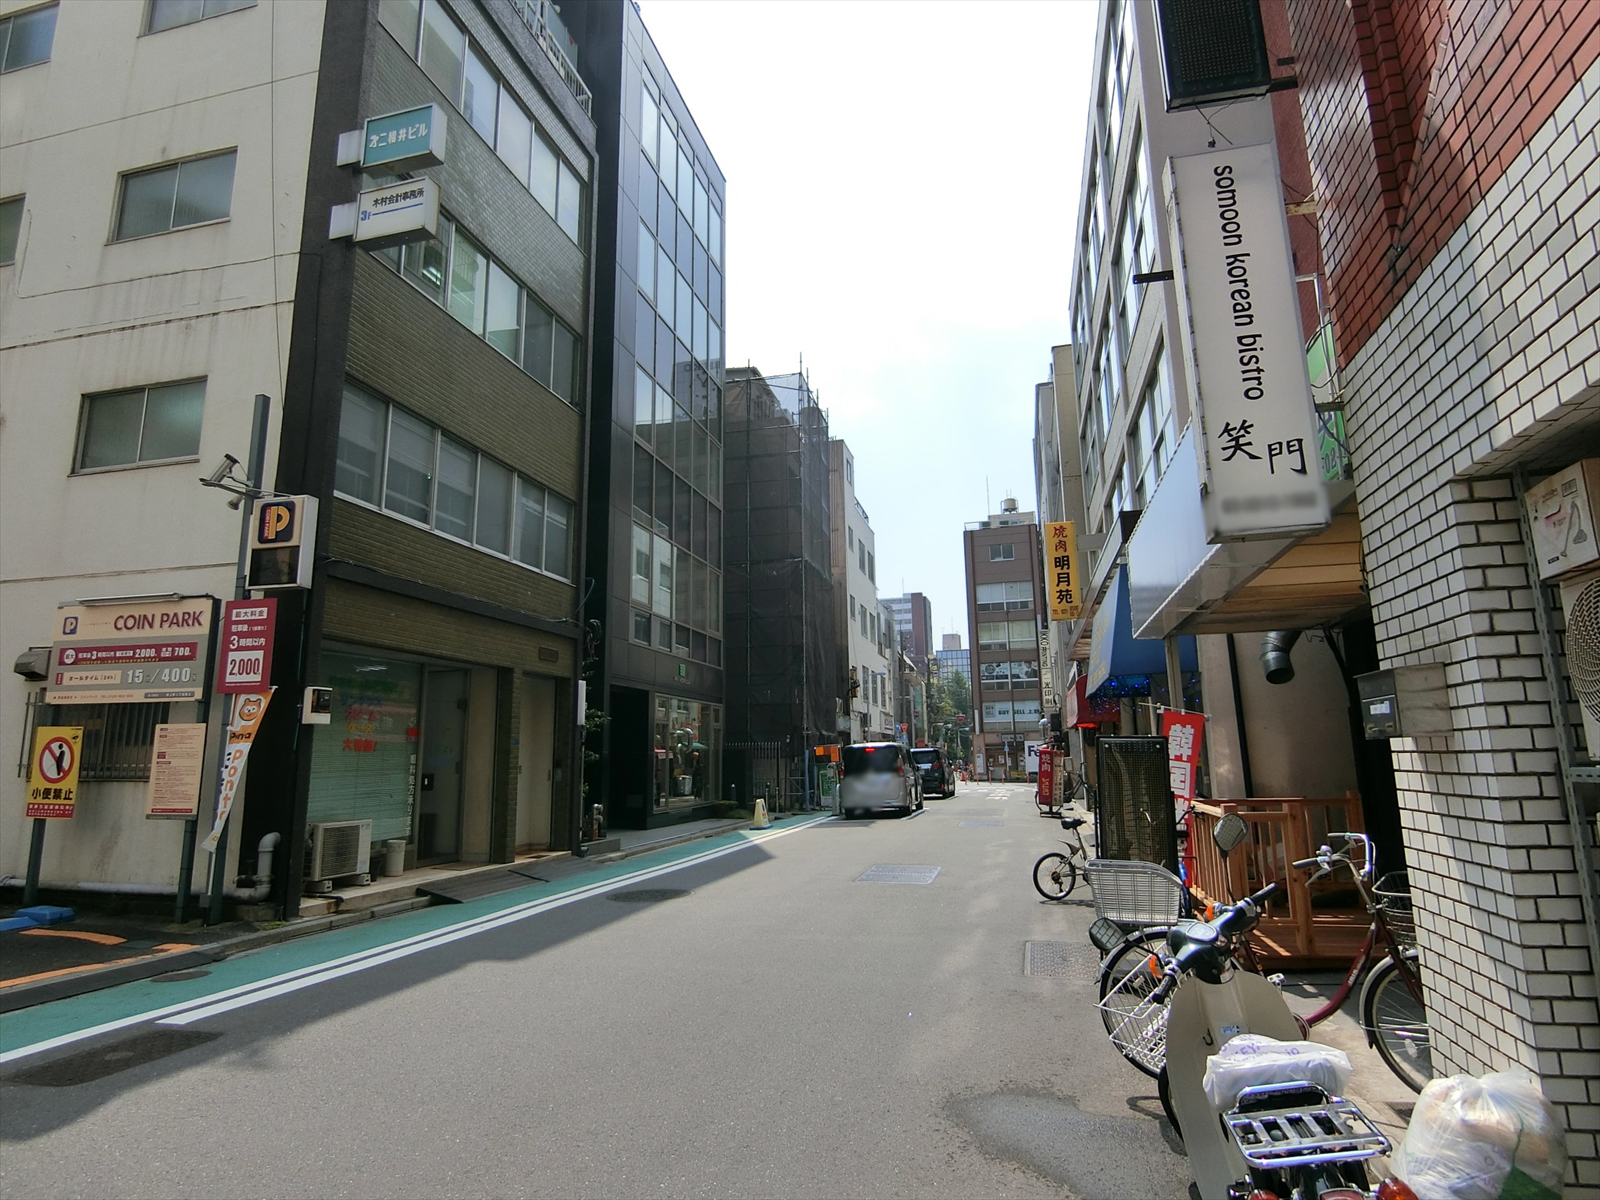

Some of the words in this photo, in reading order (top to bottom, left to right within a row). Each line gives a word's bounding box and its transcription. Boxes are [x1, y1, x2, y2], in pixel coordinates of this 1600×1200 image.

[1213, 164, 1243, 247] somoon
[1225, 252, 1253, 327] korean
[1236, 333, 1264, 401] bistro
[1052, 524, 1068, 553] 焼肉
[1054, 555, 1074, 604] 明月苑
[114, 613, 156, 631] COIN
[159, 610, 204, 629] PARK
[32, 787, 74, 801] 小便禁止
